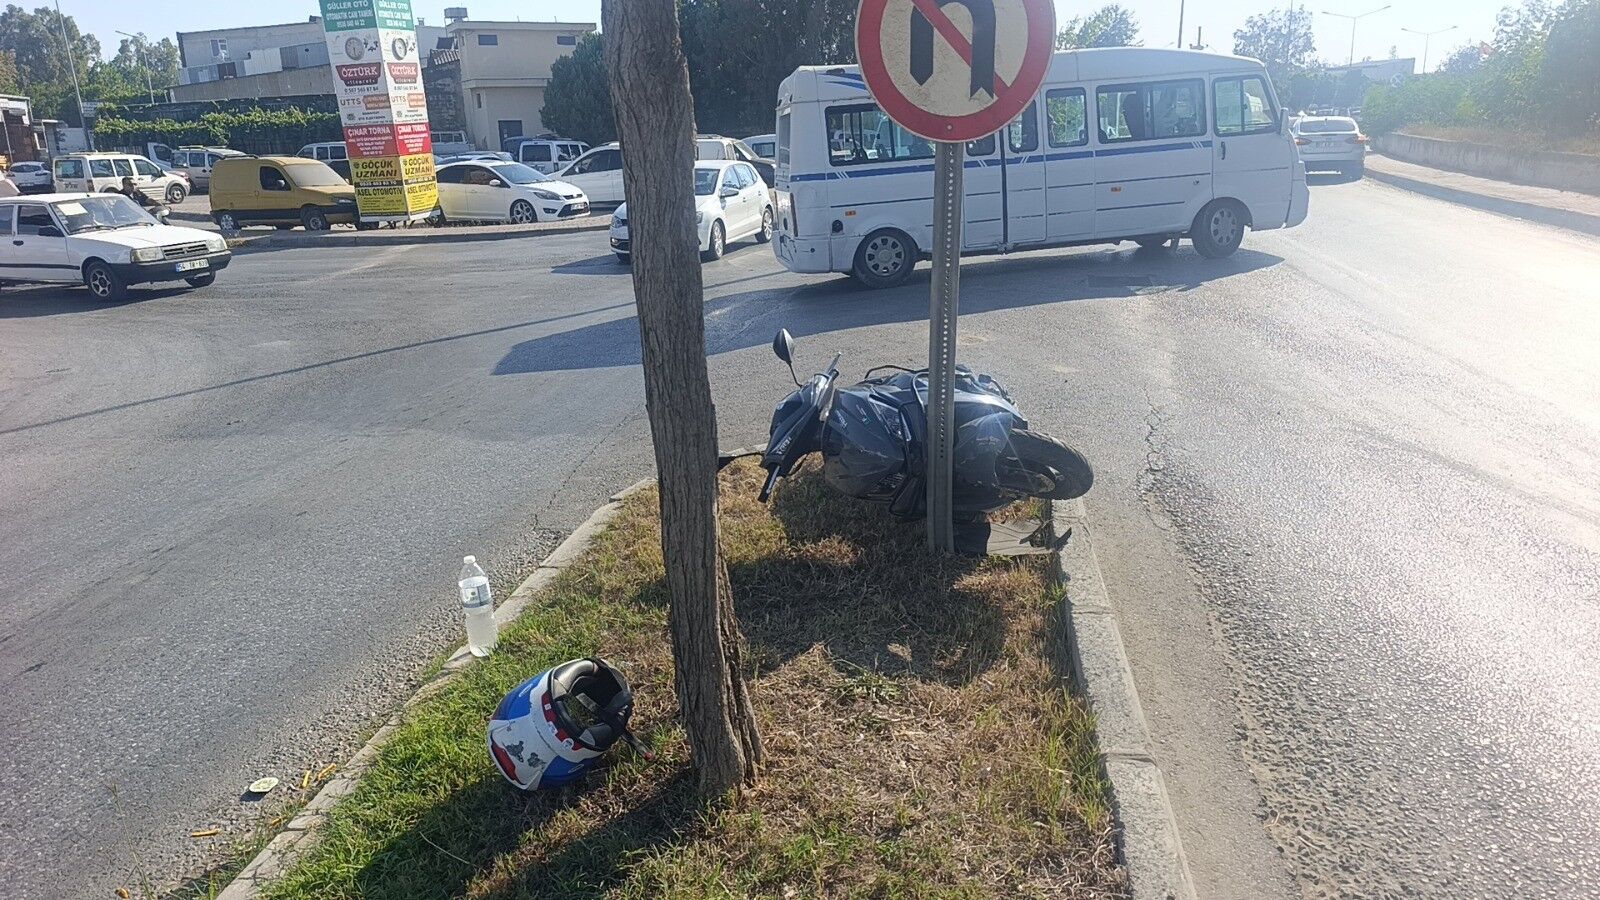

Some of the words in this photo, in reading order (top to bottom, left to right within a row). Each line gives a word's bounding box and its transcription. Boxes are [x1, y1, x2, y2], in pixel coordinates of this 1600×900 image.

[341, 66, 378, 77] ÖZTÜRK
[391, 65, 416, 75] ÖZTÜRK
[340, 98, 361, 106] UTTS
[348, 128, 368, 137] ÇINAR
[369, 127, 391, 135] TORNA
[361, 160, 393, 170] GÖÇÜK
[408, 157, 430, 166] GÖÇÜK
[356, 169, 397, 178] UZMANI
[357, 188, 372, 196] ASEL
